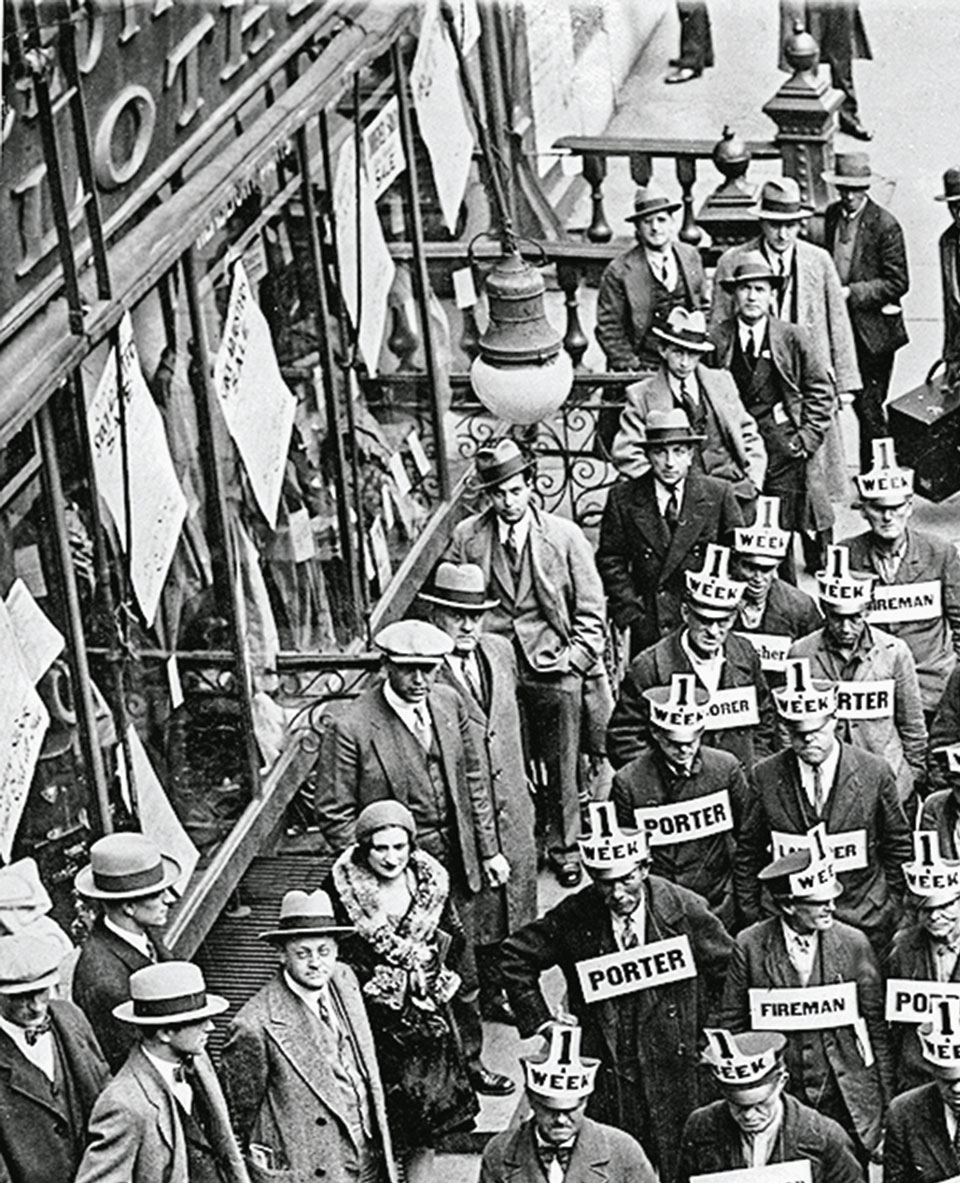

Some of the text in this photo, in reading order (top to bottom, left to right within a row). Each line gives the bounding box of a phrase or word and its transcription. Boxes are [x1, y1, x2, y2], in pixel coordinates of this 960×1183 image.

[879, 442, 890, 470] 1
[763, 501, 772, 528] 1
[712, 549, 723, 578] 1
[833, 549, 842, 578] 1
[689, 577, 737, 600] WEEK
[793, 662, 806, 692] 1
[679, 678, 688, 706] 1
[837, 692, 889, 711] RTER
[706, 699, 750, 717] ORER
[596, 806, 613, 838] 1
[644, 803, 727, 838] PORTER
[582, 841, 639, 861] WEEK
[814, 830, 826, 861] 1
[920, 834, 934, 866] 1
[588, 949, 687, 992] PORTER
[761, 998, 846, 1017] FIREMAN
[938, 1002, 954, 1035] 1
[558, 1031, 573, 1065] 1
[713, 1031, 734, 1060] 1
